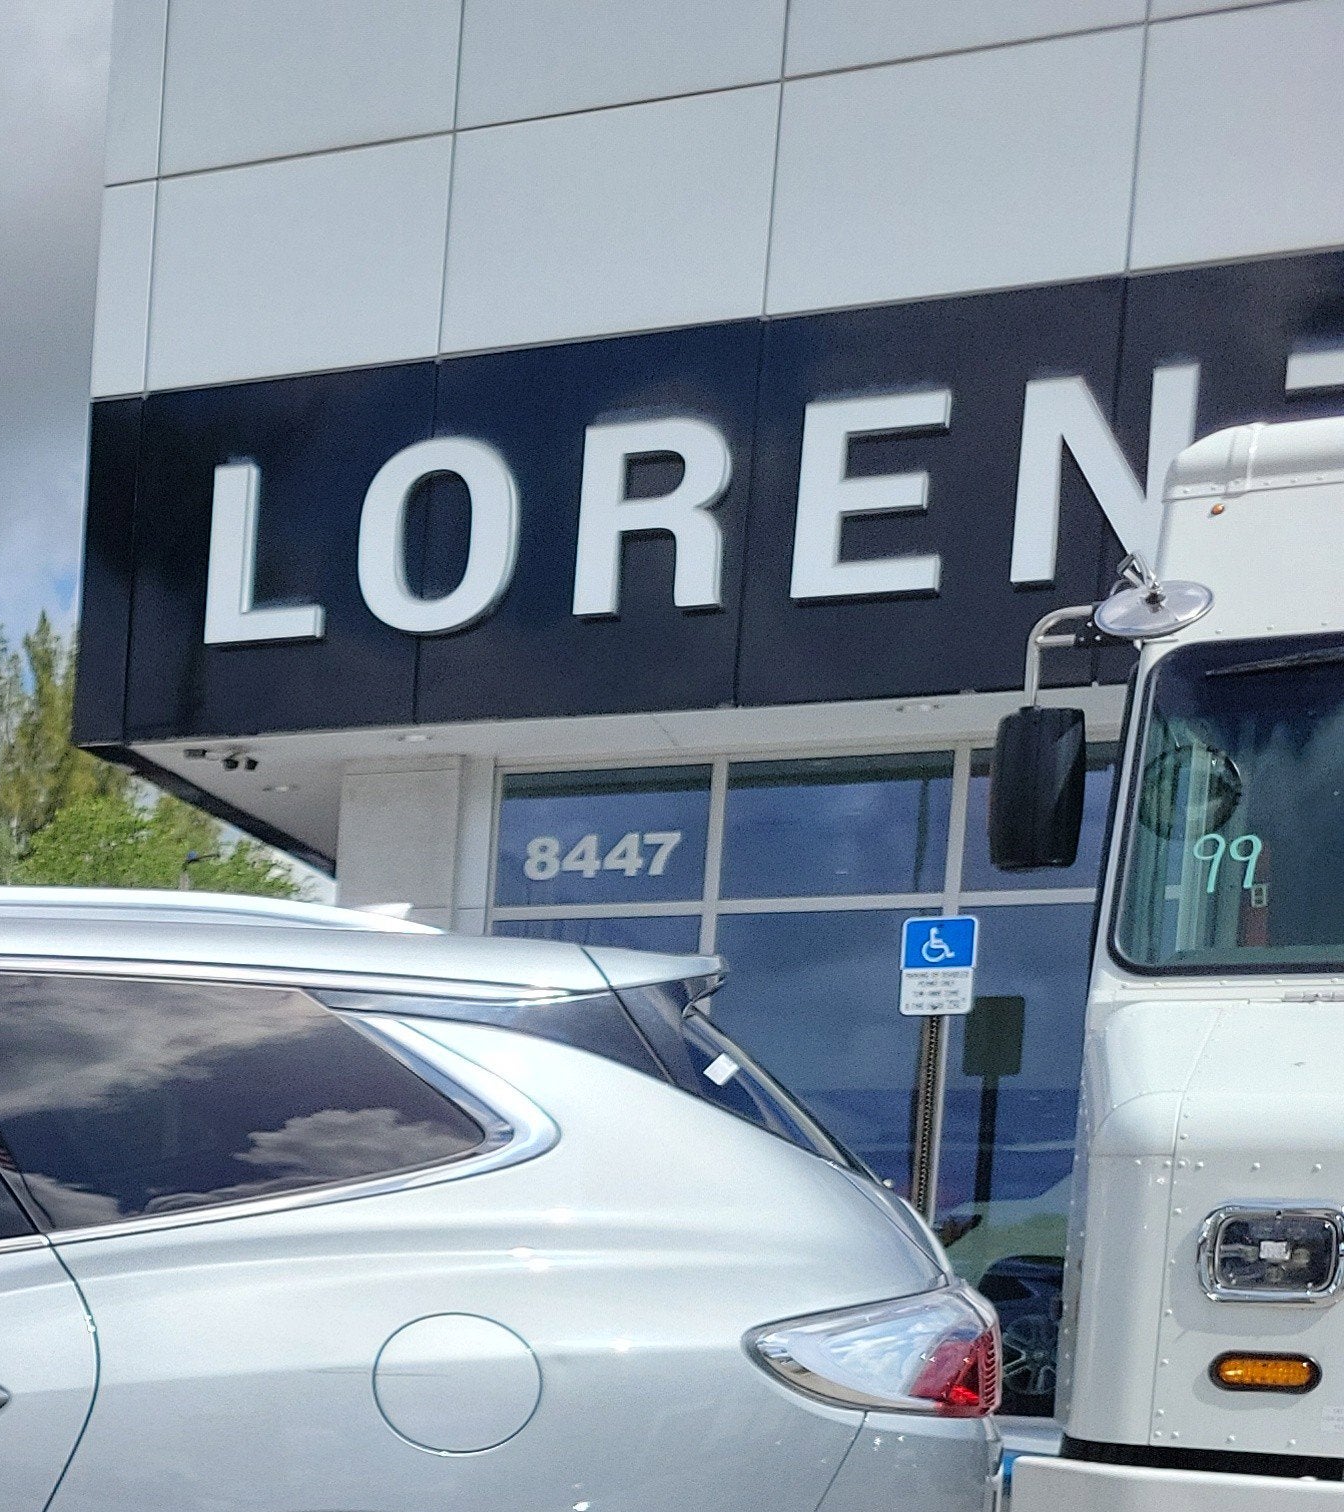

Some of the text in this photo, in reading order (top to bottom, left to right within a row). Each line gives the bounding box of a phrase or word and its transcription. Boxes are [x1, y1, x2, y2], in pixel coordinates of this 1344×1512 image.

[203, 350, 1344, 648] LOREN
[523, 831, 682, 881] 8447
[1193, 833, 1262, 893] 99
